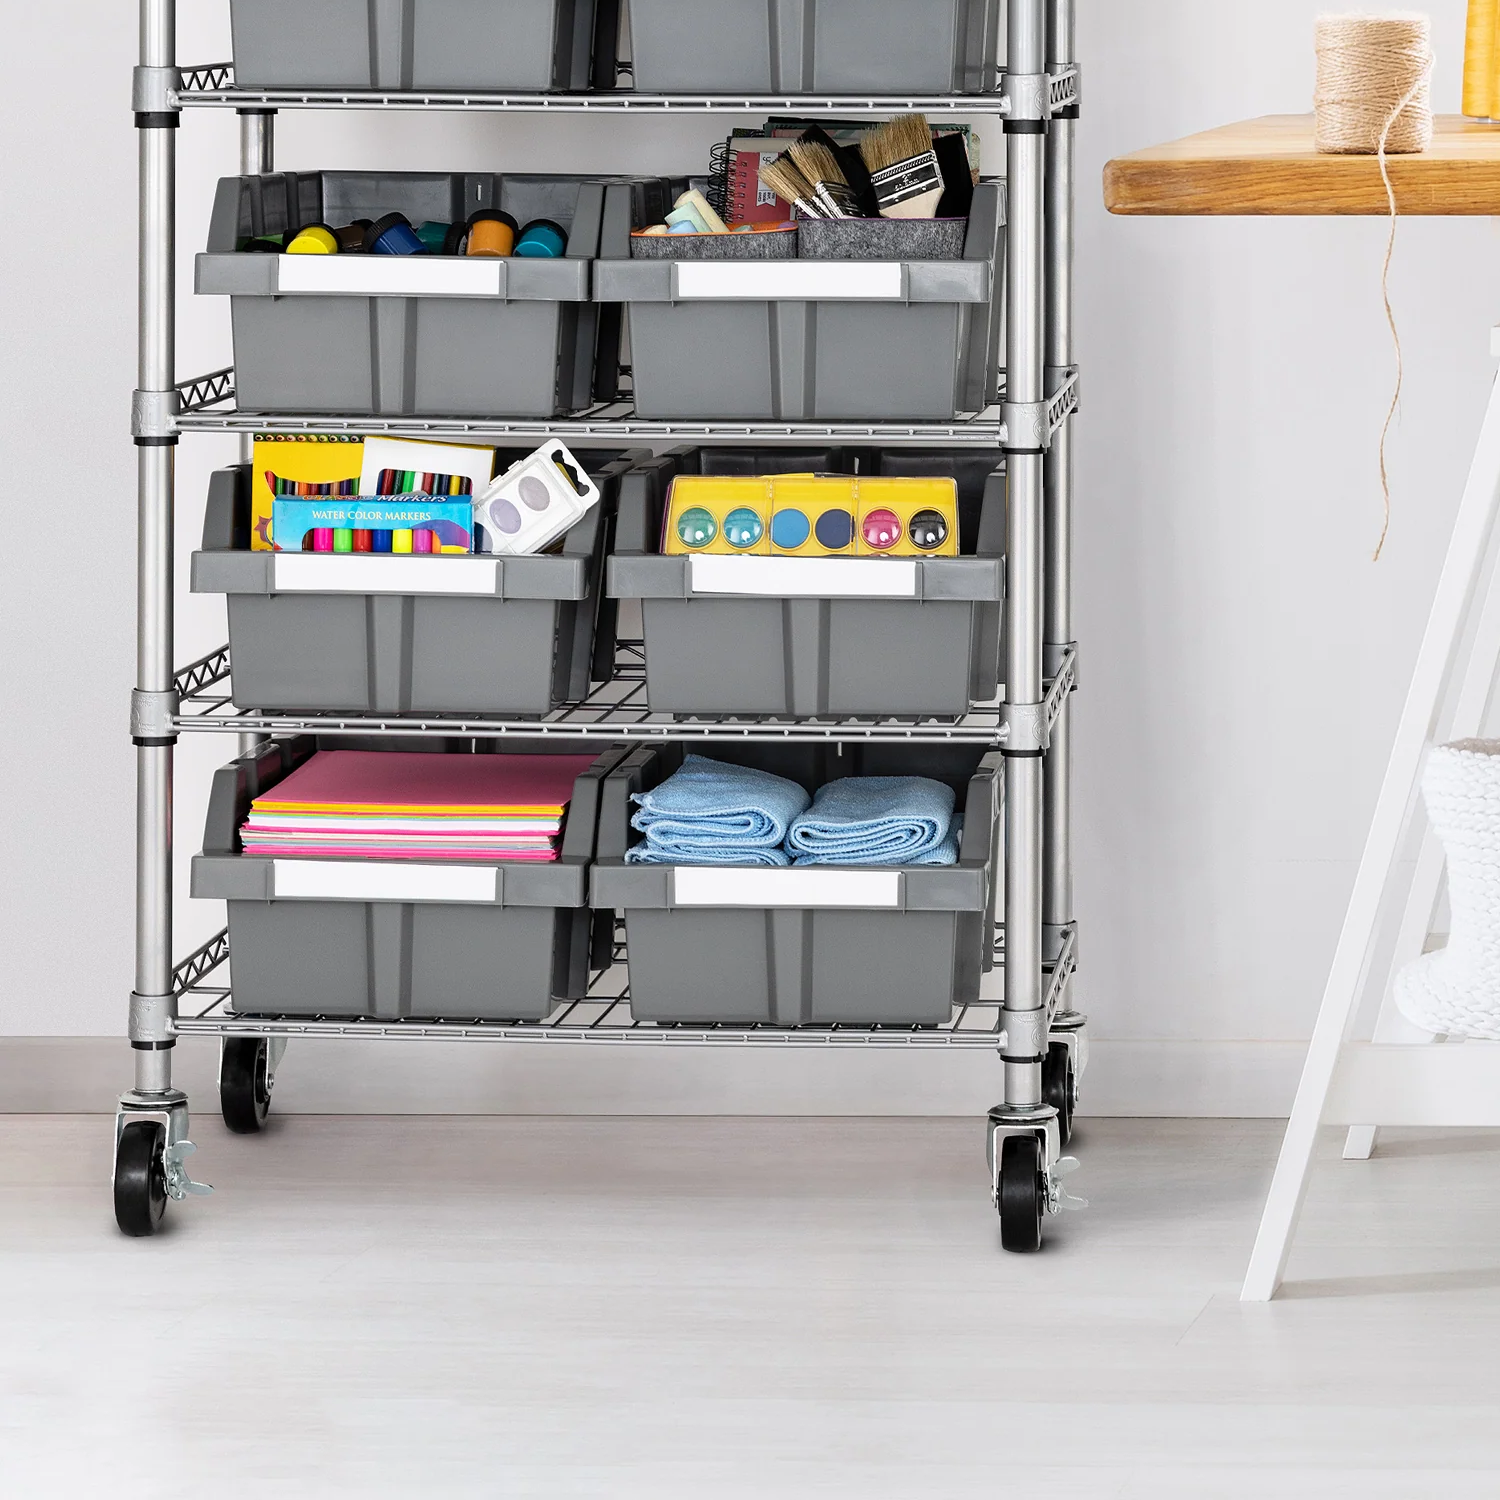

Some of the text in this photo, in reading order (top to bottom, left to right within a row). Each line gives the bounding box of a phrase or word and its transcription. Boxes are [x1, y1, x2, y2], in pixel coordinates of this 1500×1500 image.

[312, 510, 431, 521] WATER COLOR MARKERS
